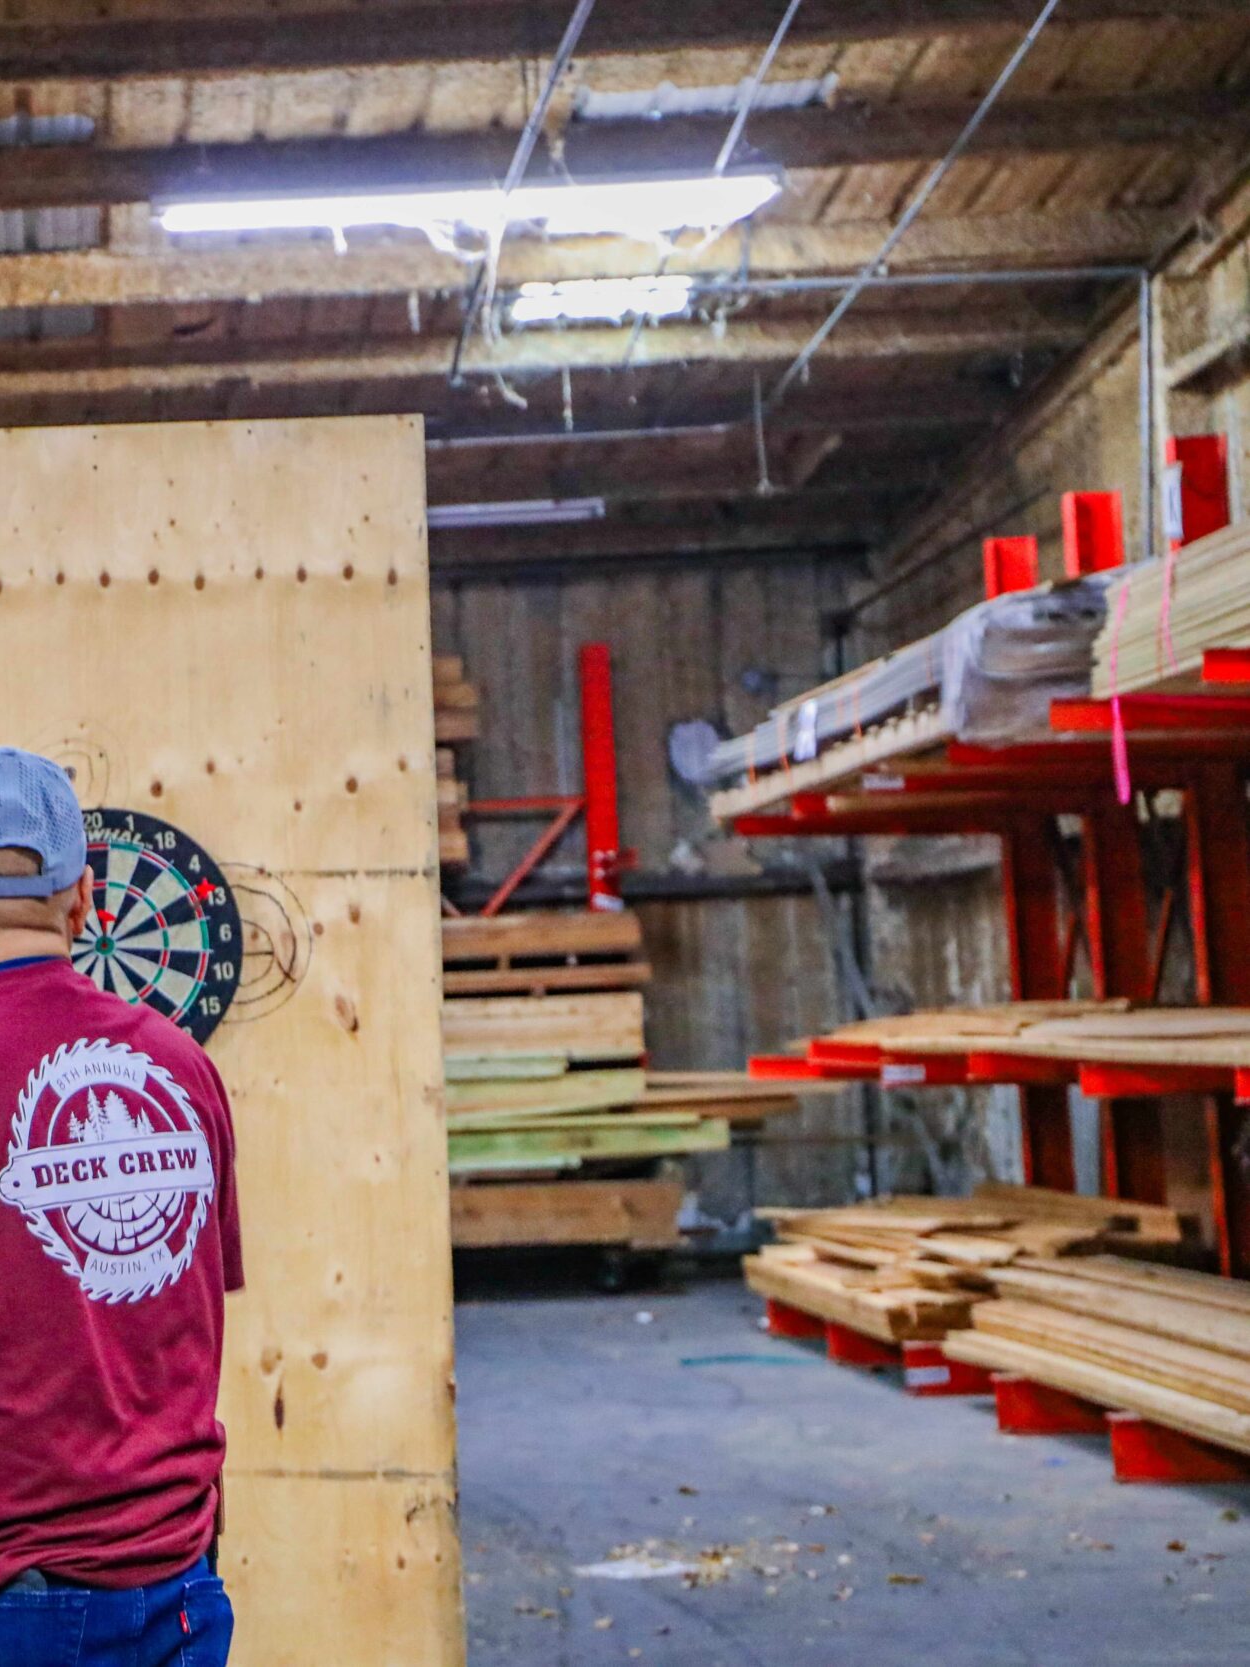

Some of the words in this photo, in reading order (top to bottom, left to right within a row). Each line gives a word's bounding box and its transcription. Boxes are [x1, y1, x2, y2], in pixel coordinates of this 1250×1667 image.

[82, 812, 102, 829] 20
[125, 814, 135, 832] 1
[87, 828, 144, 848] WHAL
[154, 830, 177, 850] 18
[189, 854, 201, 873] 4
[207, 886, 226, 907] 13
[219, 923, 232, 942] 6
[212, 961, 234, 981] 10
[199, 996, 221, 1016] 15
[56, 1066, 81, 1090] 8TH
[84, 1061, 137, 1082] ANNUAL
[31, 1156, 108, 1188] DECK
[118, 1148, 197, 1175] CREW
[90, 1258, 147, 1276] AUSTIN,
[151, 1248, 165, 1265] TX
